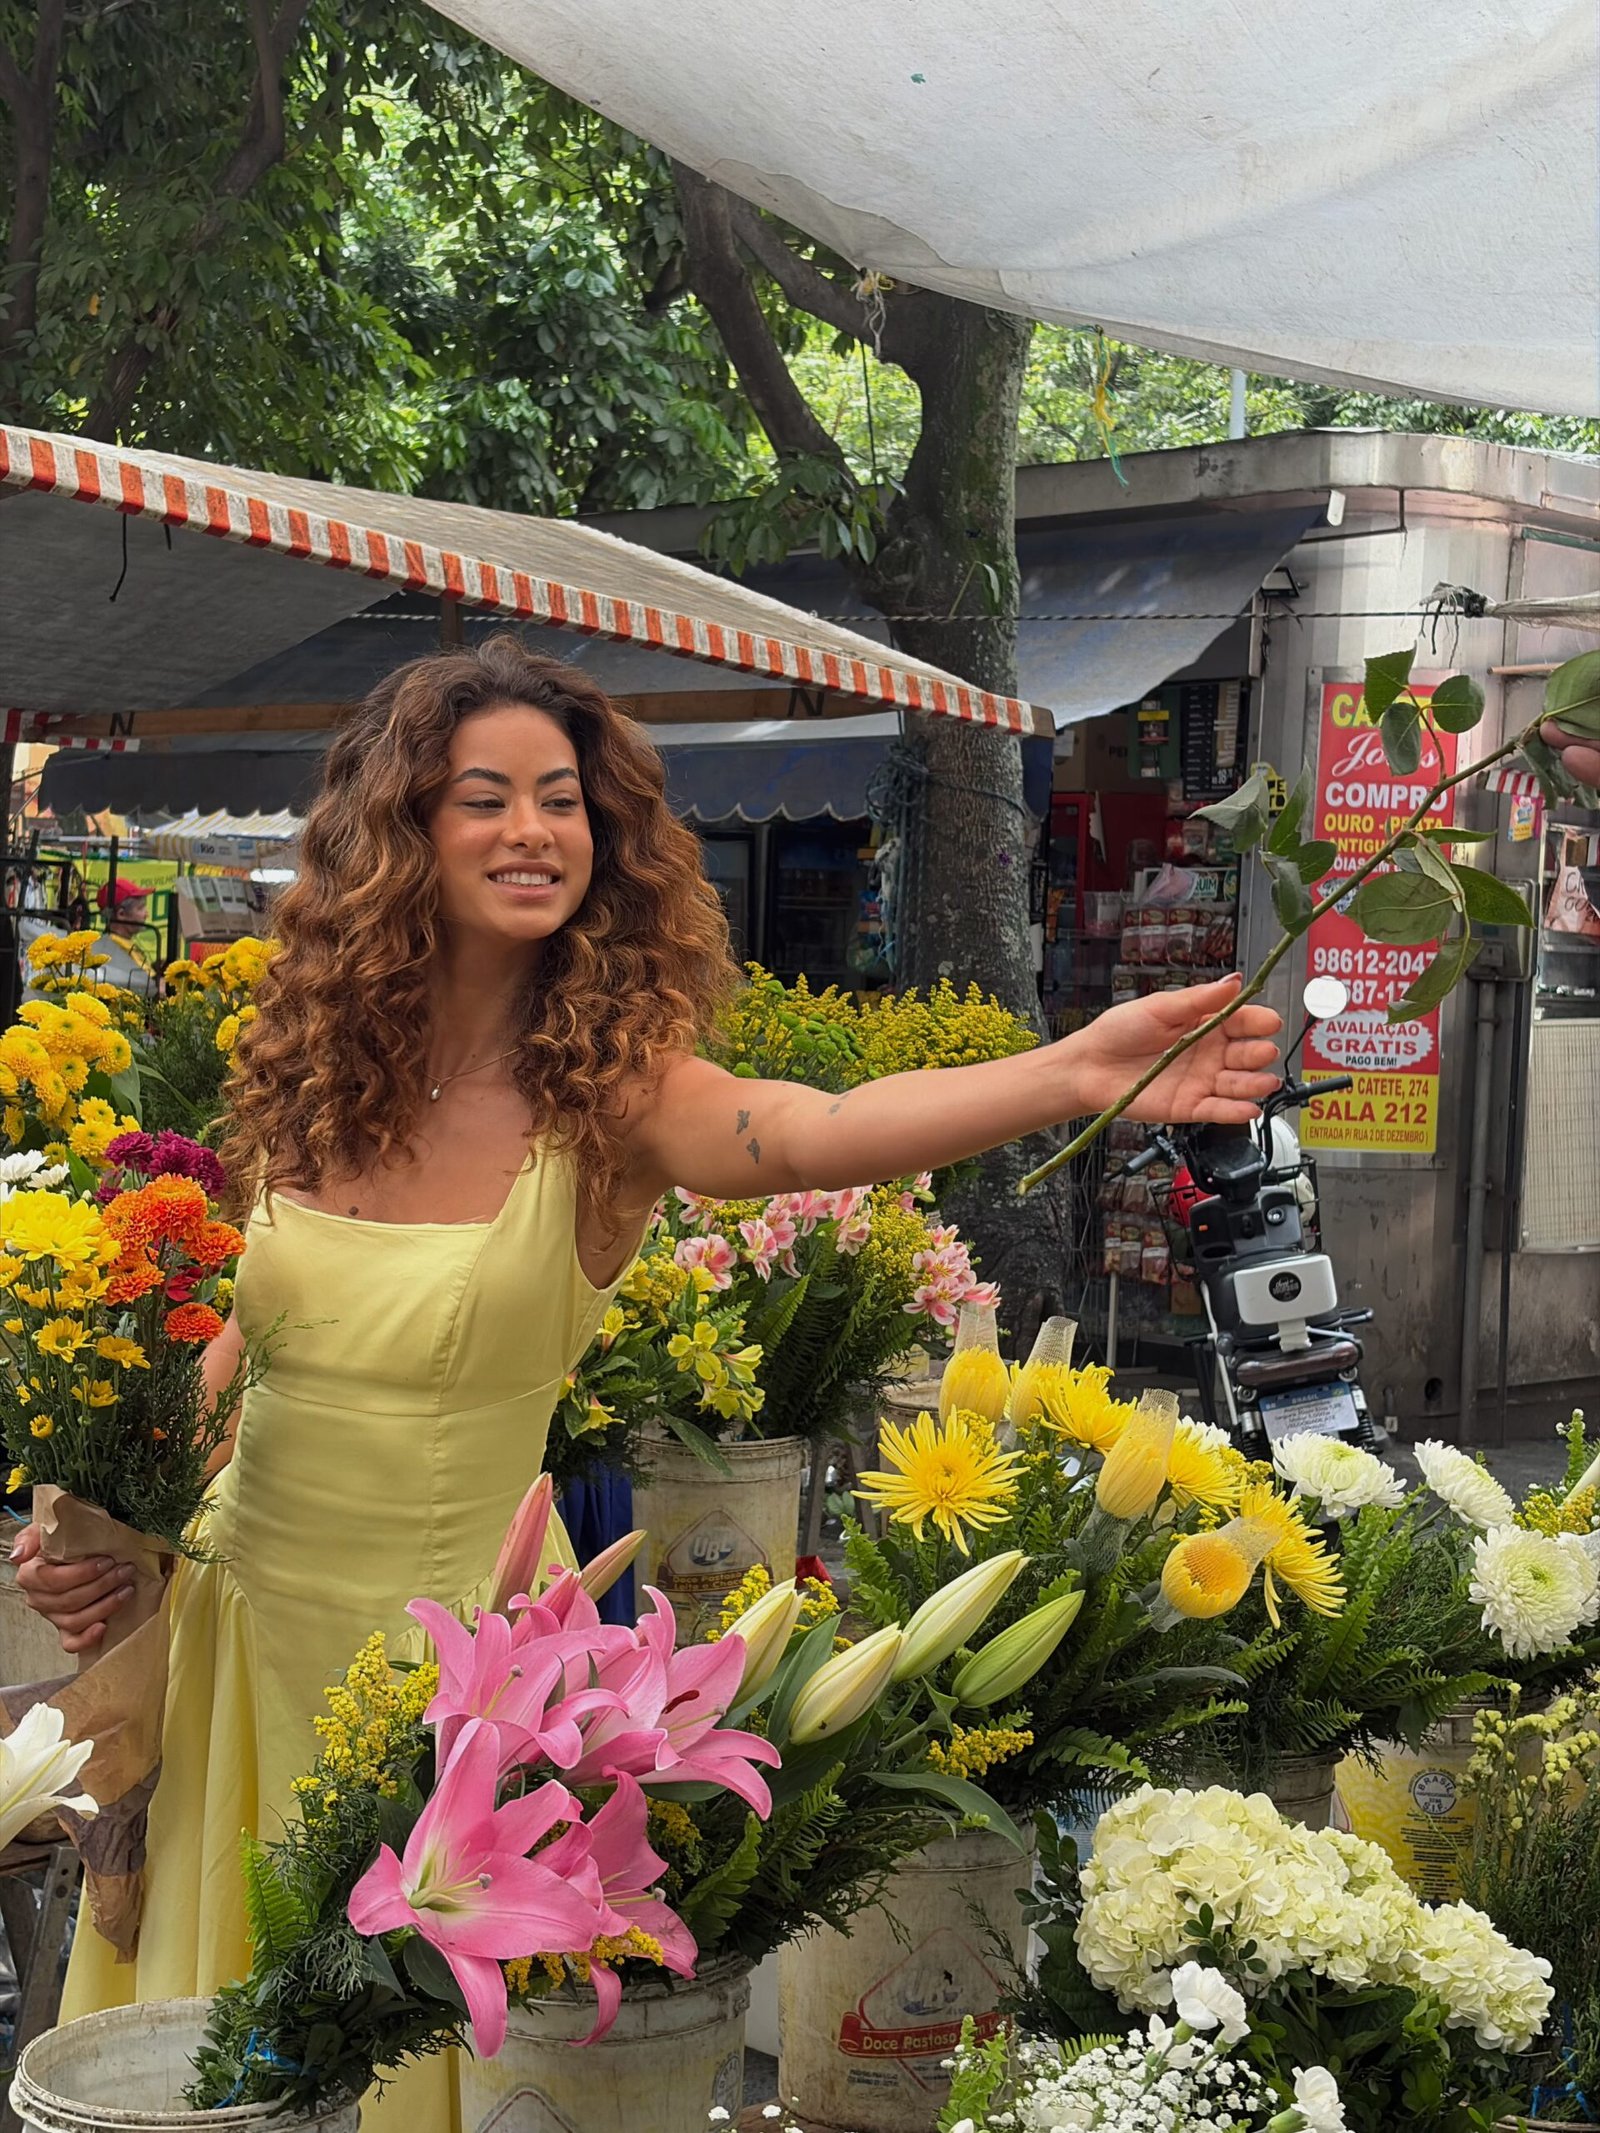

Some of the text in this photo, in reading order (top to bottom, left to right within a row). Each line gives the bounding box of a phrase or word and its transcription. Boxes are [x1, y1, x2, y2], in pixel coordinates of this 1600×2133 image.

[1332, 731, 1439, 776] Jos
[1325, 782, 1447, 811] COMPRO
[1324, 813, 1374, 833] OURO
[1314, 947, 1438, 976] 98612-2047
[1326, 1036, 1417, 1055] GRÁTIS
[1346, 1056, 1397, 1066] PAGO BEM!
[1358, 1077, 1405, 1099] CATETE,
[1409, 1080, 1429, 1097] 274
[1309, 1099, 1427, 1124] SALA 212
[1354, 1128, 1368, 1141] RUA
[1369, 1129, 1374, 1141] 2
[1375, 1129, 1384, 1142] DE
[1418, 1775, 1454, 1793] BRASIL
[862, 2031, 957, 2051] Doce Pastoso
